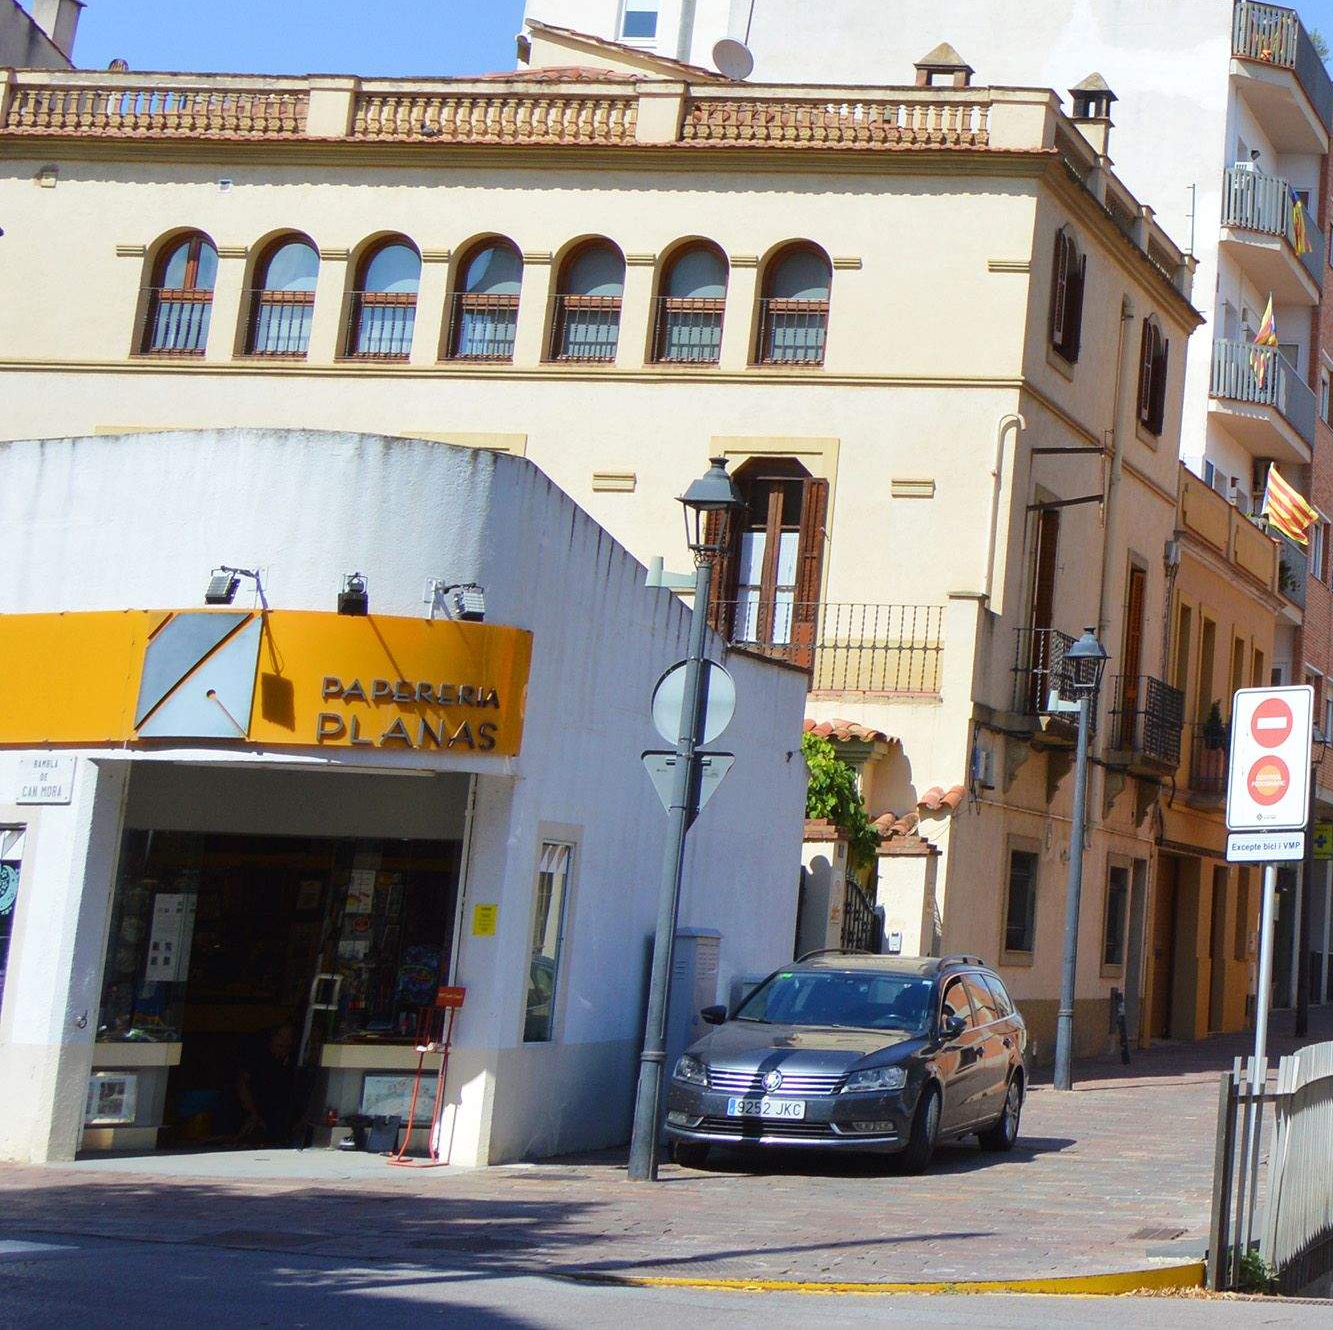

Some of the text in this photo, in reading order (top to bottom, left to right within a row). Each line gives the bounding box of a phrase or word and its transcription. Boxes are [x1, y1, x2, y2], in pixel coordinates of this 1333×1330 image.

[322, 676, 500, 709] PAPERERIA
[316, 712, 498, 751] PLANAS
[22, 785, 38, 797] CAN
[1232, 843, 1261, 852] Excepte
[1263, 842, 1277, 851] bici
[1282, 841, 1301, 850] VMP
[737, 1101, 802, 1117] 9252 JKC
